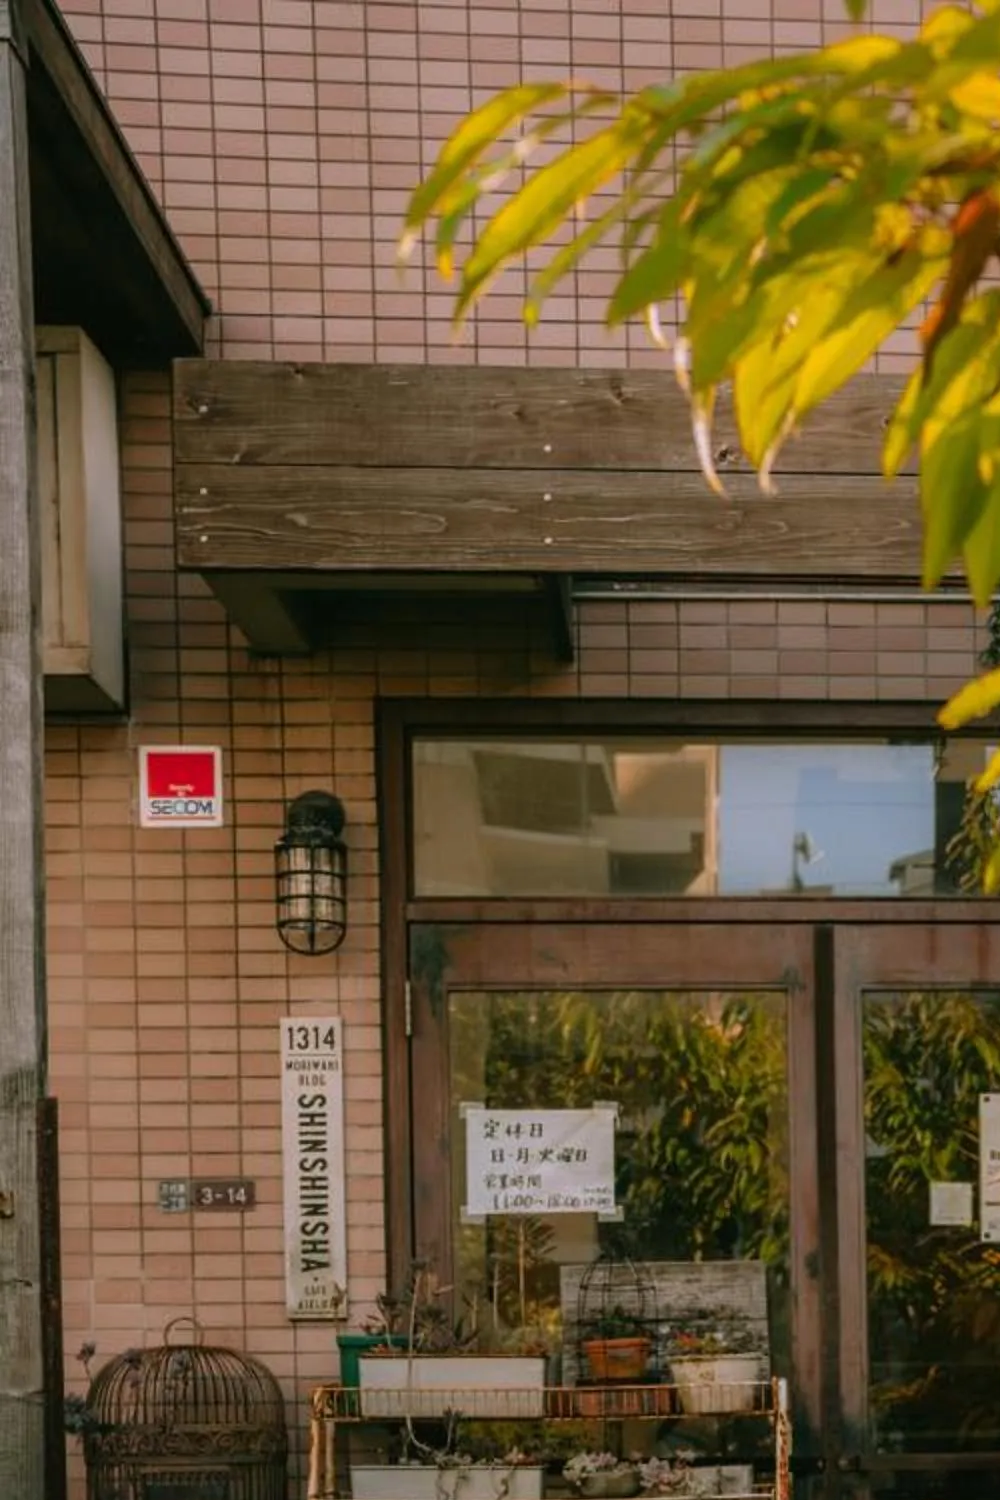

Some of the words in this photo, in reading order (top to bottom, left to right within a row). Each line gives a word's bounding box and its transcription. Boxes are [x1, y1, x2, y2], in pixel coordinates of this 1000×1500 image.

[151, 799, 214, 815] SECOM
[286, 1025, 336, 1051] 1314
[298, 1093, 331, 1273] SHINSHINSHA
[201, 1187, 247, 1205] 3-14
